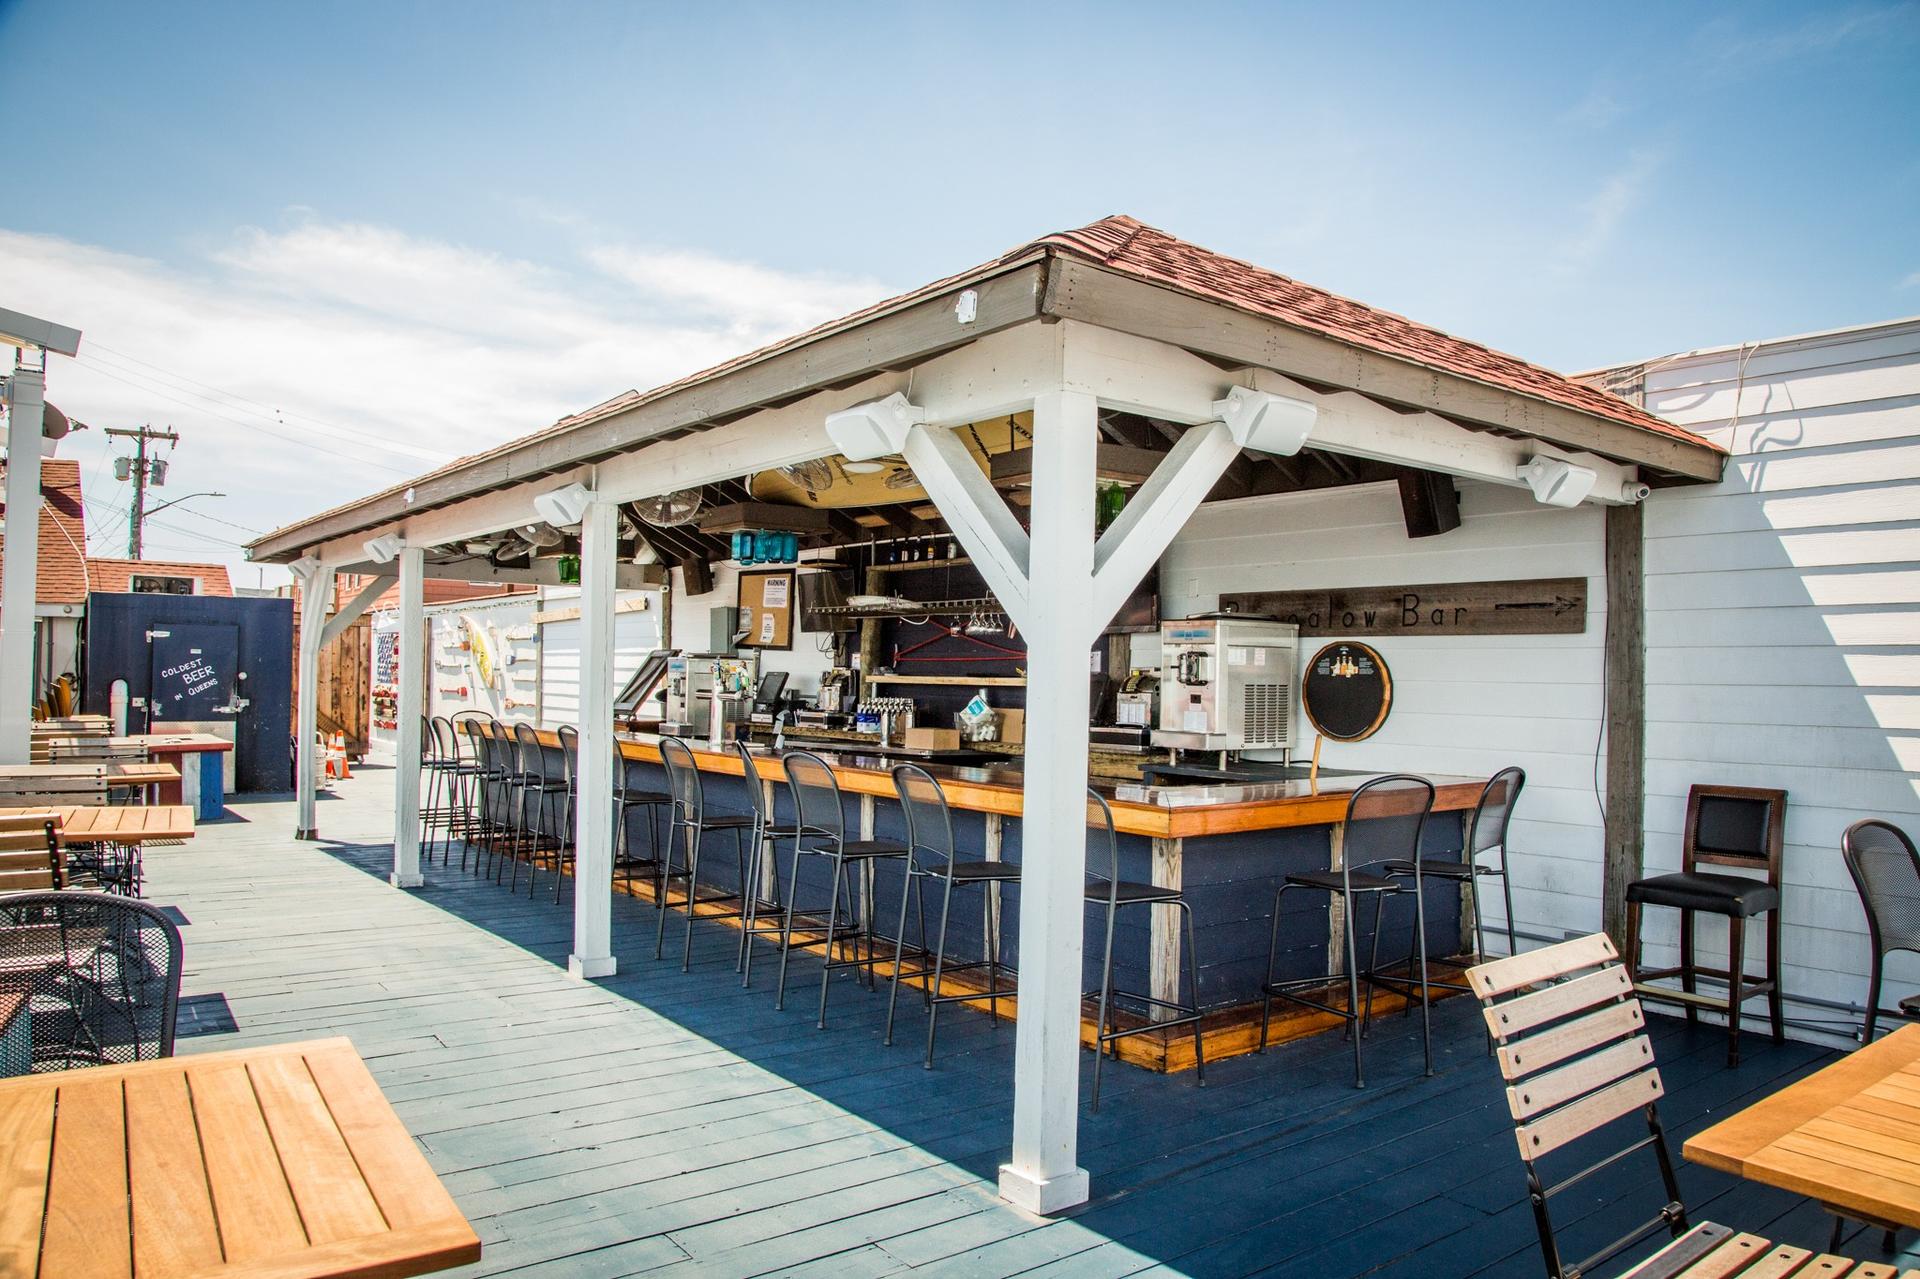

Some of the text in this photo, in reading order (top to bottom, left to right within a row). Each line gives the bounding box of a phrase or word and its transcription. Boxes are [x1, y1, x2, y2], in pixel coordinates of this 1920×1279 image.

[1401, 593, 1468, 627] Bar
[161, 658, 202, 678] COLDEST
[182, 665, 215, 685] BEER
[174, 678, 218, 701] IN QUEENS
